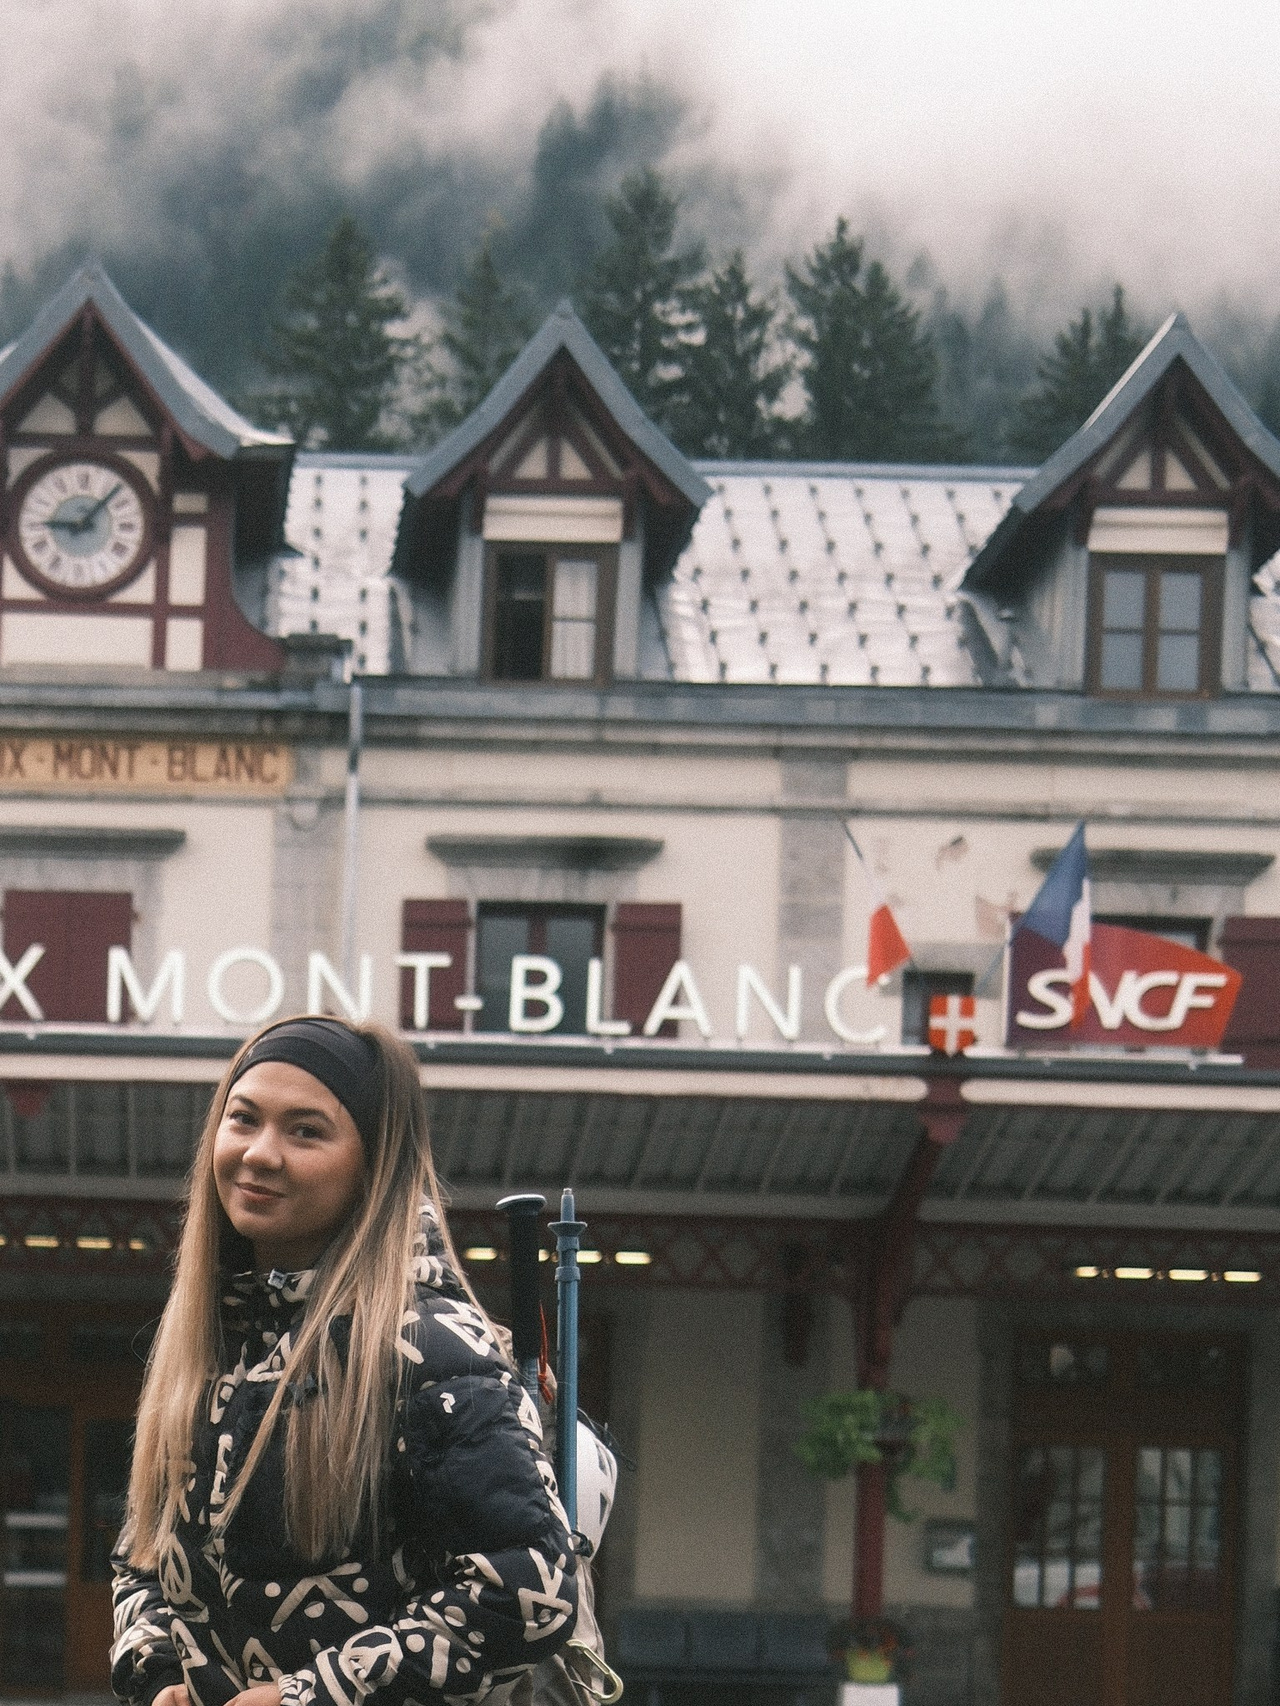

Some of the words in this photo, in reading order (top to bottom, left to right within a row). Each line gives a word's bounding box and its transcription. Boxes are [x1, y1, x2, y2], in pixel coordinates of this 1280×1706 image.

[52, 741, 141, 780] MONT
[167, 742, 280, 783] BLANC
[1016, 968, 1228, 1031] SNCF
